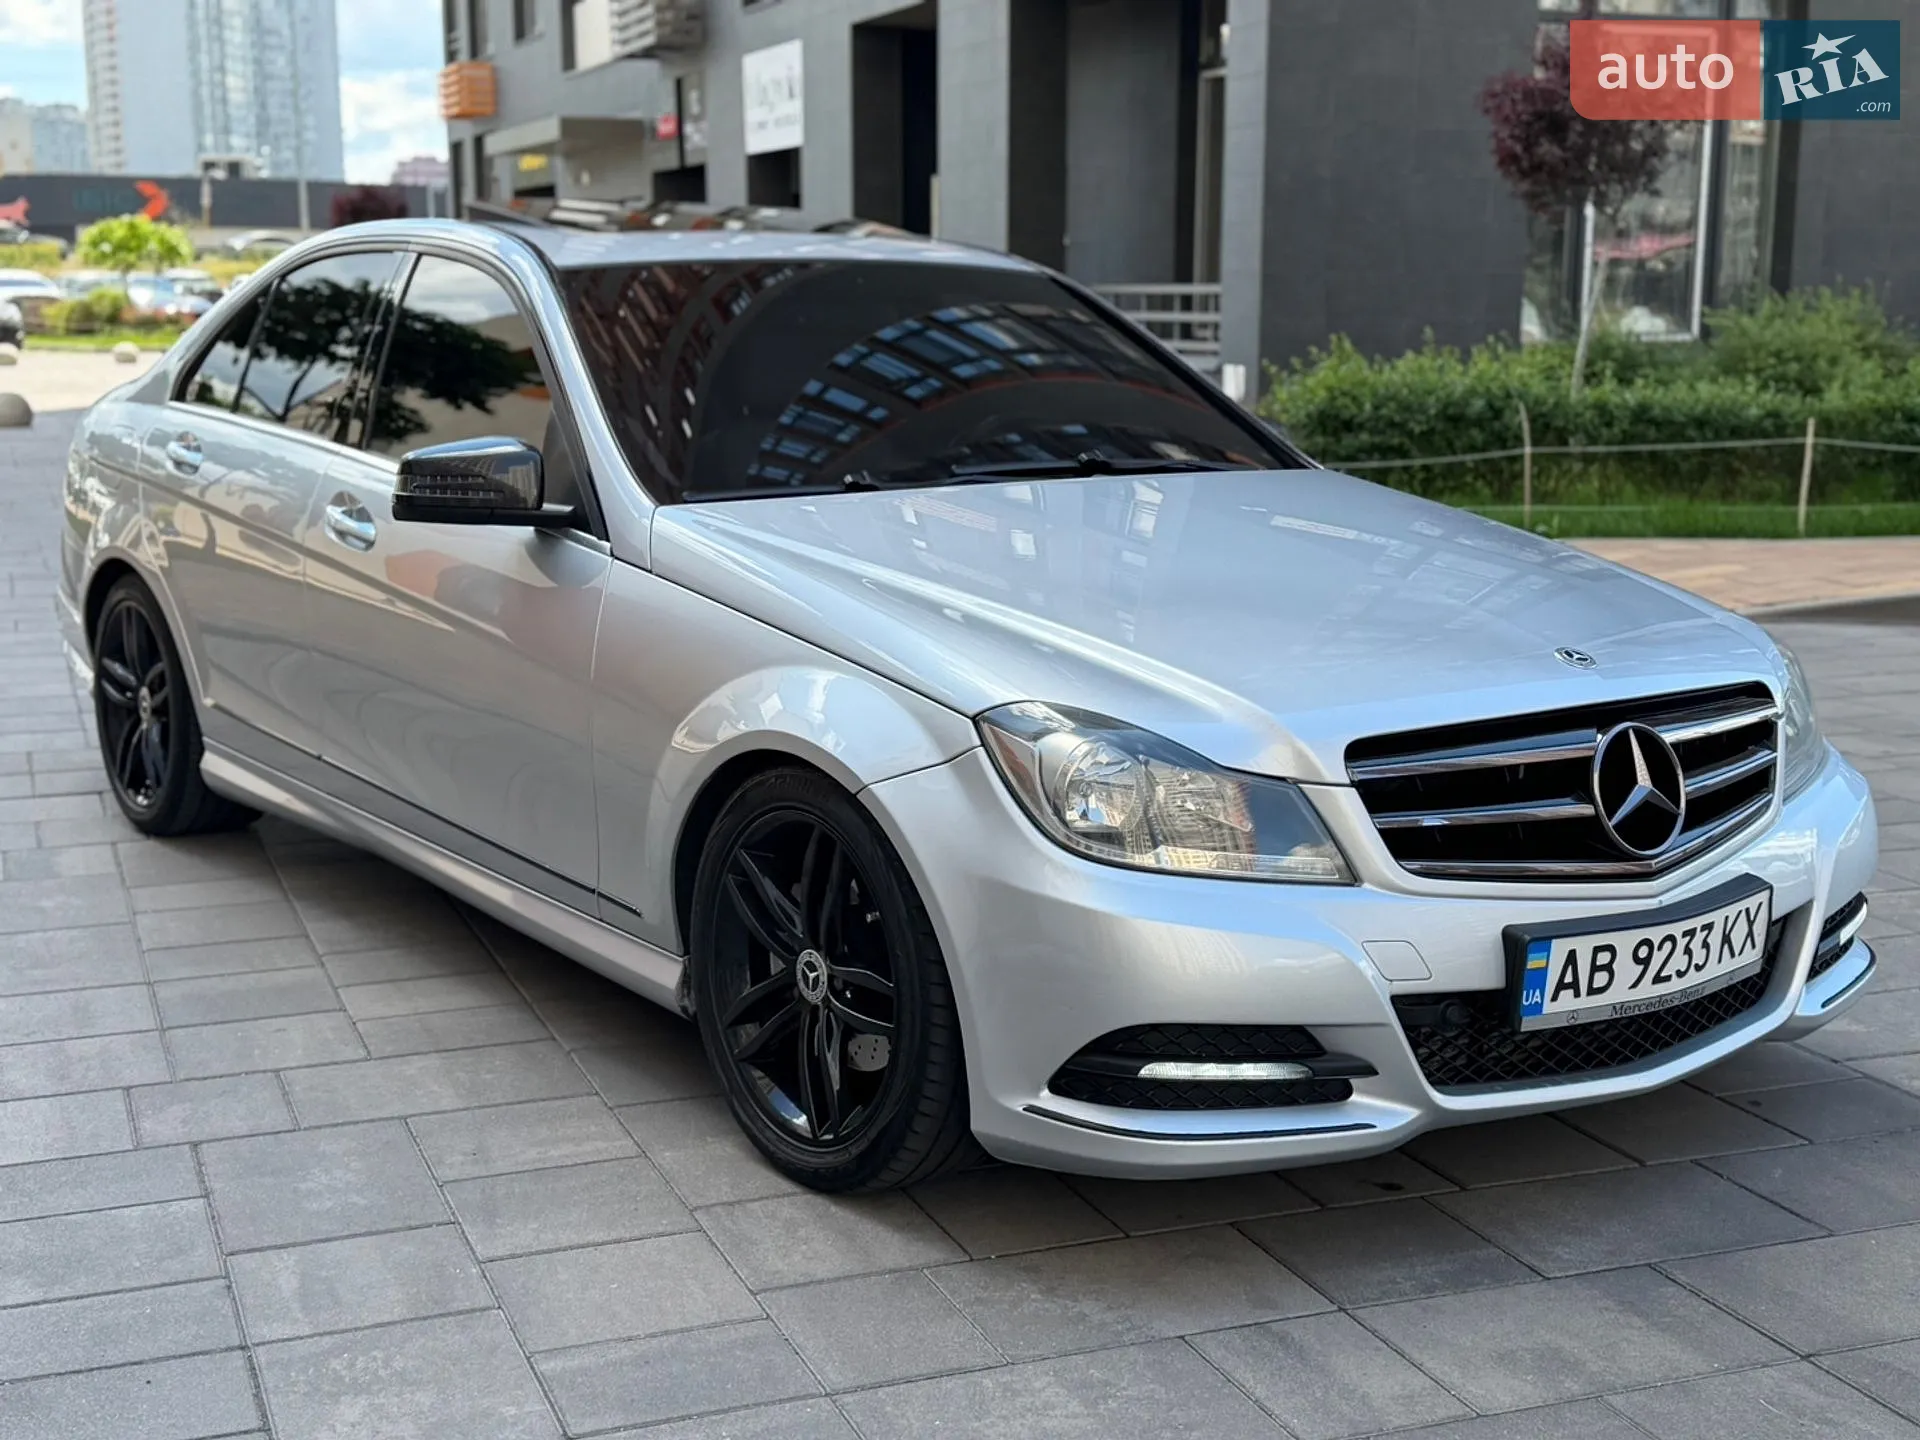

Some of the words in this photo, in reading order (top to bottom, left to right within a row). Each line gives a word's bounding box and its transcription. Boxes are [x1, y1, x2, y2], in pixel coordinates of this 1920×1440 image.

[1550, 943, 1617, 1003] AB
[1628, 921, 1715, 990] 9233
[1522, 989, 1542, 1006] UA
[1609, 986, 1706, 1017] Mercedes-Benz
